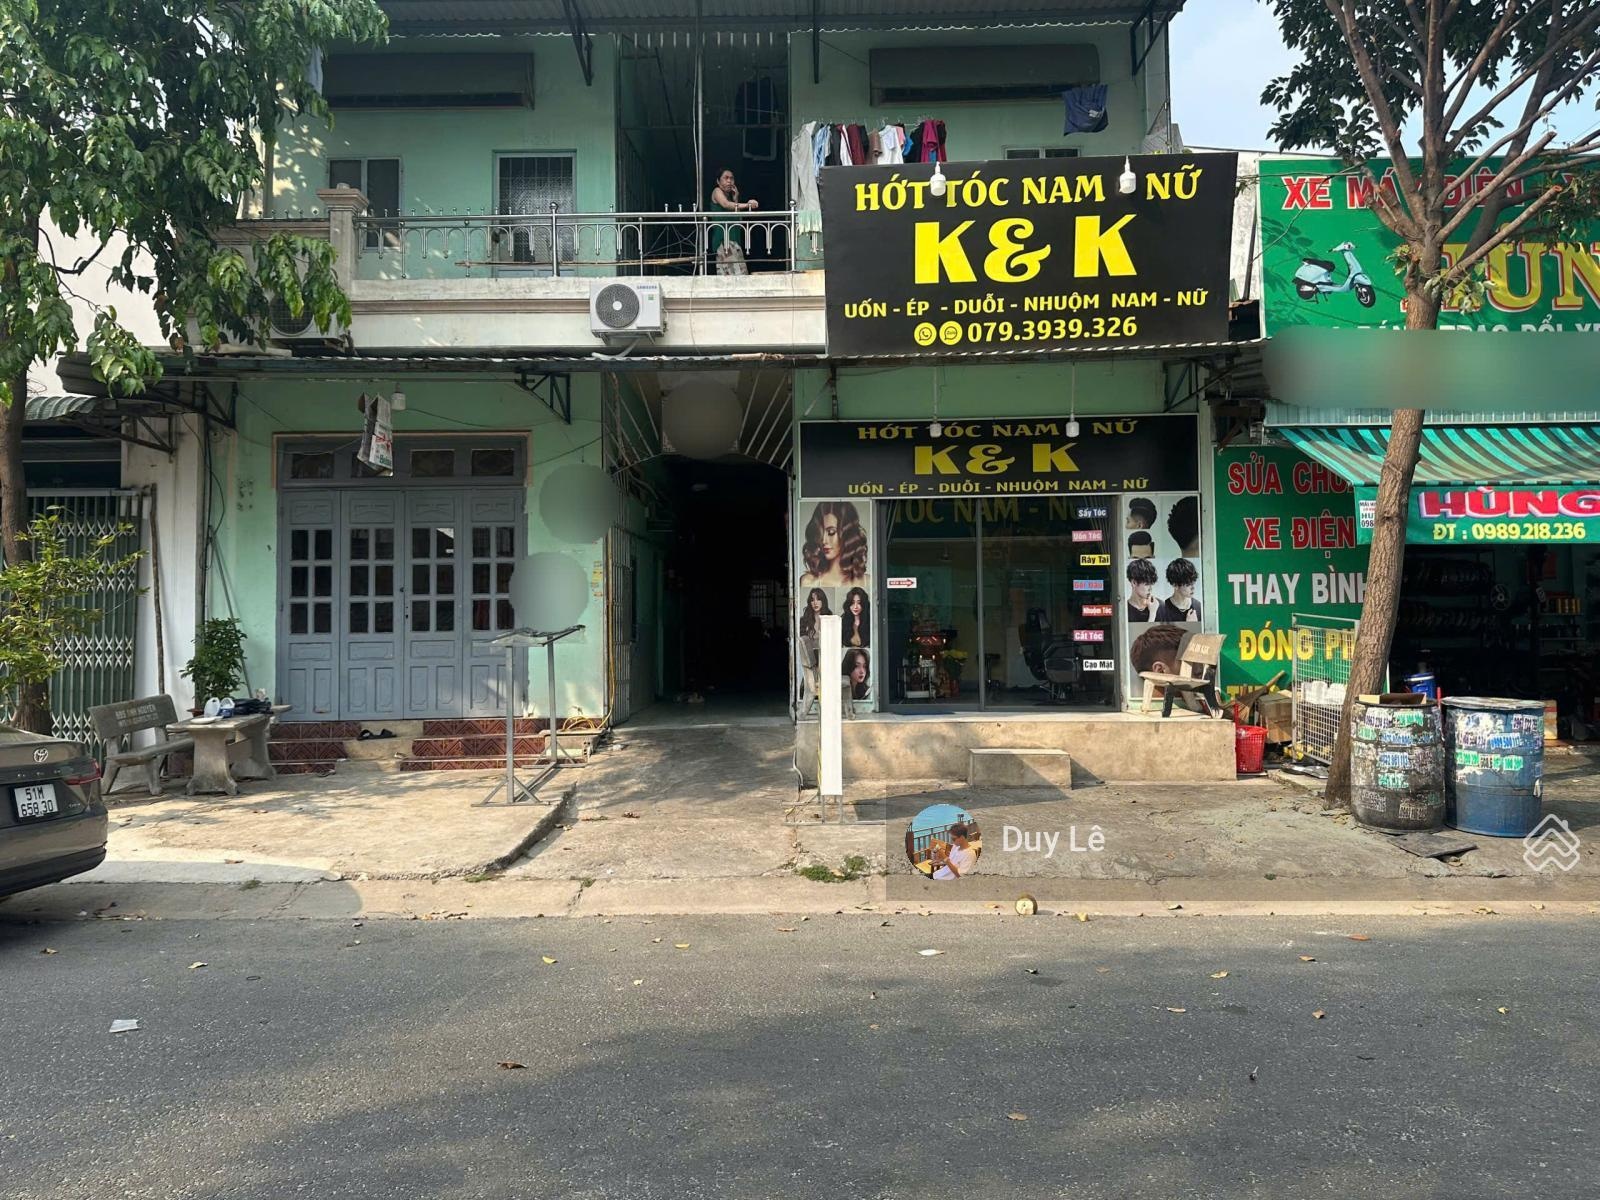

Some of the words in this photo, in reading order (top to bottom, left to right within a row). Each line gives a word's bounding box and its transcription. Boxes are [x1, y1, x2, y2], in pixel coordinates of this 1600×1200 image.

[855, 173, 929, 211] HỚT
[945, 169, 1009, 208] TÓC
[1021, 174, 1106, 205] NAM
[1145, 163, 1203, 200] NỮ
[1281, 176, 1333, 210] XE
[1346, 166, 1424, 209] MÁ
[844, 299, 888, 319] UỐN
[906, 300, 930, 316] ÉP
[954, 293, 1005, 314] DUỖI
[1023, 292, 1099, 312] NHUỘM
[1111, 293, 1157, 309] NAM
[1177, 289, 1209, 306] NỮ
[968, 316, 1138, 342] 079.3939.326
[858, 422, 917, 440] HỚT
[993, 422, 1060, 437] NAM
[1093, 419, 1138, 435] NỮ
[848, 478, 884, 495] UỐN
[899, 479, 920, 494] ÉP
[939, 477, 981, 493] DUỖI
[996, 478, 1059, 493] NHUỘM
[1069, 479, 1107, 491] NAM
[1123, 477, 1150, 490] NỮ
[1228, 451, 1283, 495] SỬA
[1419, 486, 1600, 518] HÙNG
[1243, 517, 1281, 549] XE
[1291, 509, 1355, 558] ĐIỆN
[1433, 523, 1457, 540] ĐT
[1471, 522, 1586, 540] 0989.218.236
[1228, 573, 1300, 605] THAY
[1239, 621, 1314, 661] ĐÓNG
[25, 787, 45, 801] 51M
